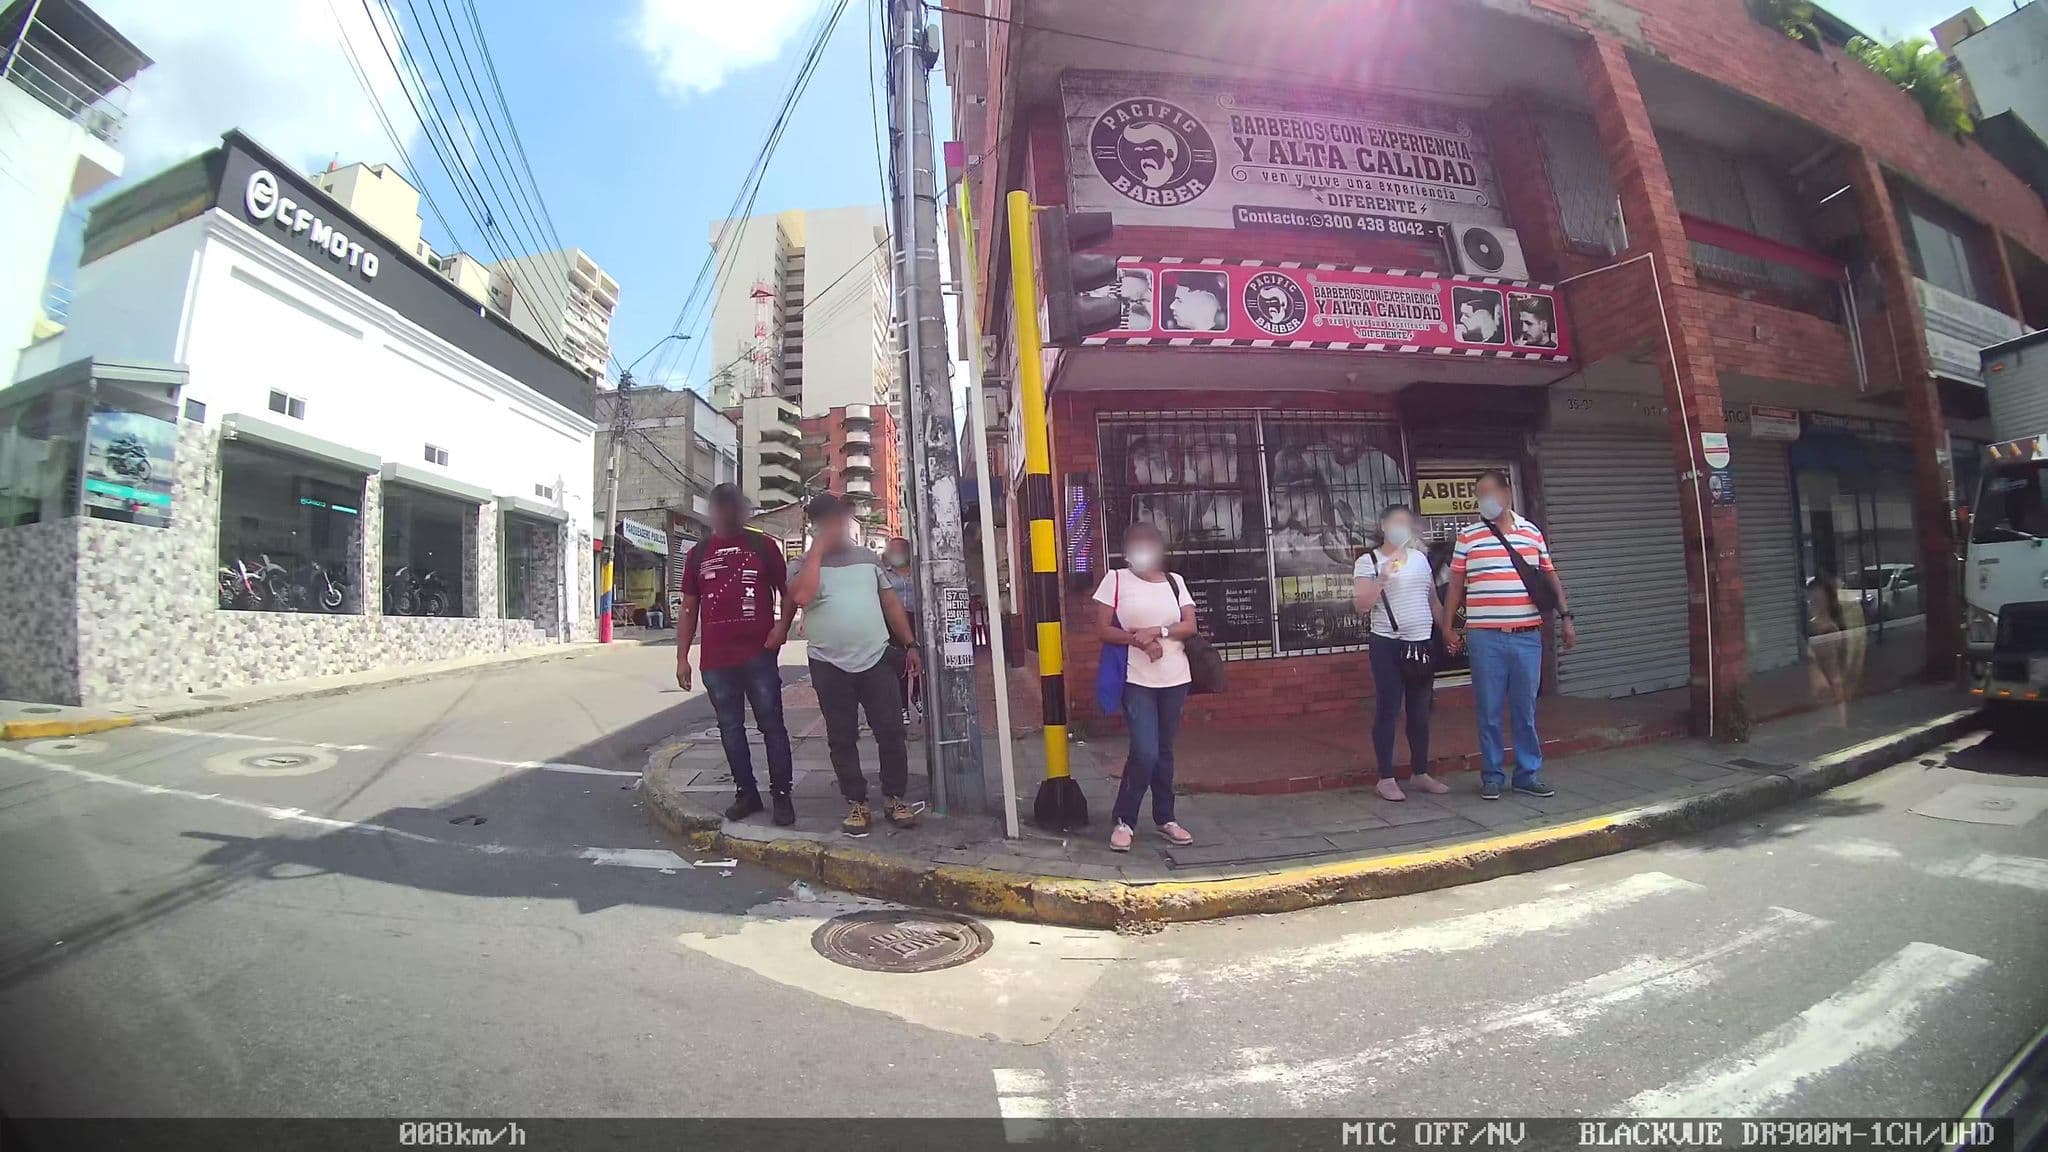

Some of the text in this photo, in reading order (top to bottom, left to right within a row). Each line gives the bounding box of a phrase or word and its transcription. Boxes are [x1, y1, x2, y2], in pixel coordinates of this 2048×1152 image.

[1102, 103, 1198, 134] PACIFIC
[1230, 114, 1472, 161] BARBEROS CON EXPERIENCIA
[1233, 137, 1478, 187] Y ALTA CALIDAD
[1111, 174, 1206, 205] BARBER
[1262, 171, 1456, 201] ven y vive una experiencia
[1328, 193, 1418, 215] DIFERENTE
[1239, 208, 1310, 226] Contacto:
[1323, 213, 1352, 230] 300
[1357, 216, 1384, 232] 438
[1389, 220, 1425, 236] 8042
[276, 197, 379, 278] CFMOTO
[1250, 275, 1297, 293] PACIFIC
[1314, 286, 1440, 305] BARBEROS CON EXPERIENCIA
[1315, 300, 1441, 320] Y ALTA CALIDAD
[1256, 317, 1301, 333] BARBER
[1361, 330, 1408, 339] DIFERENTE
